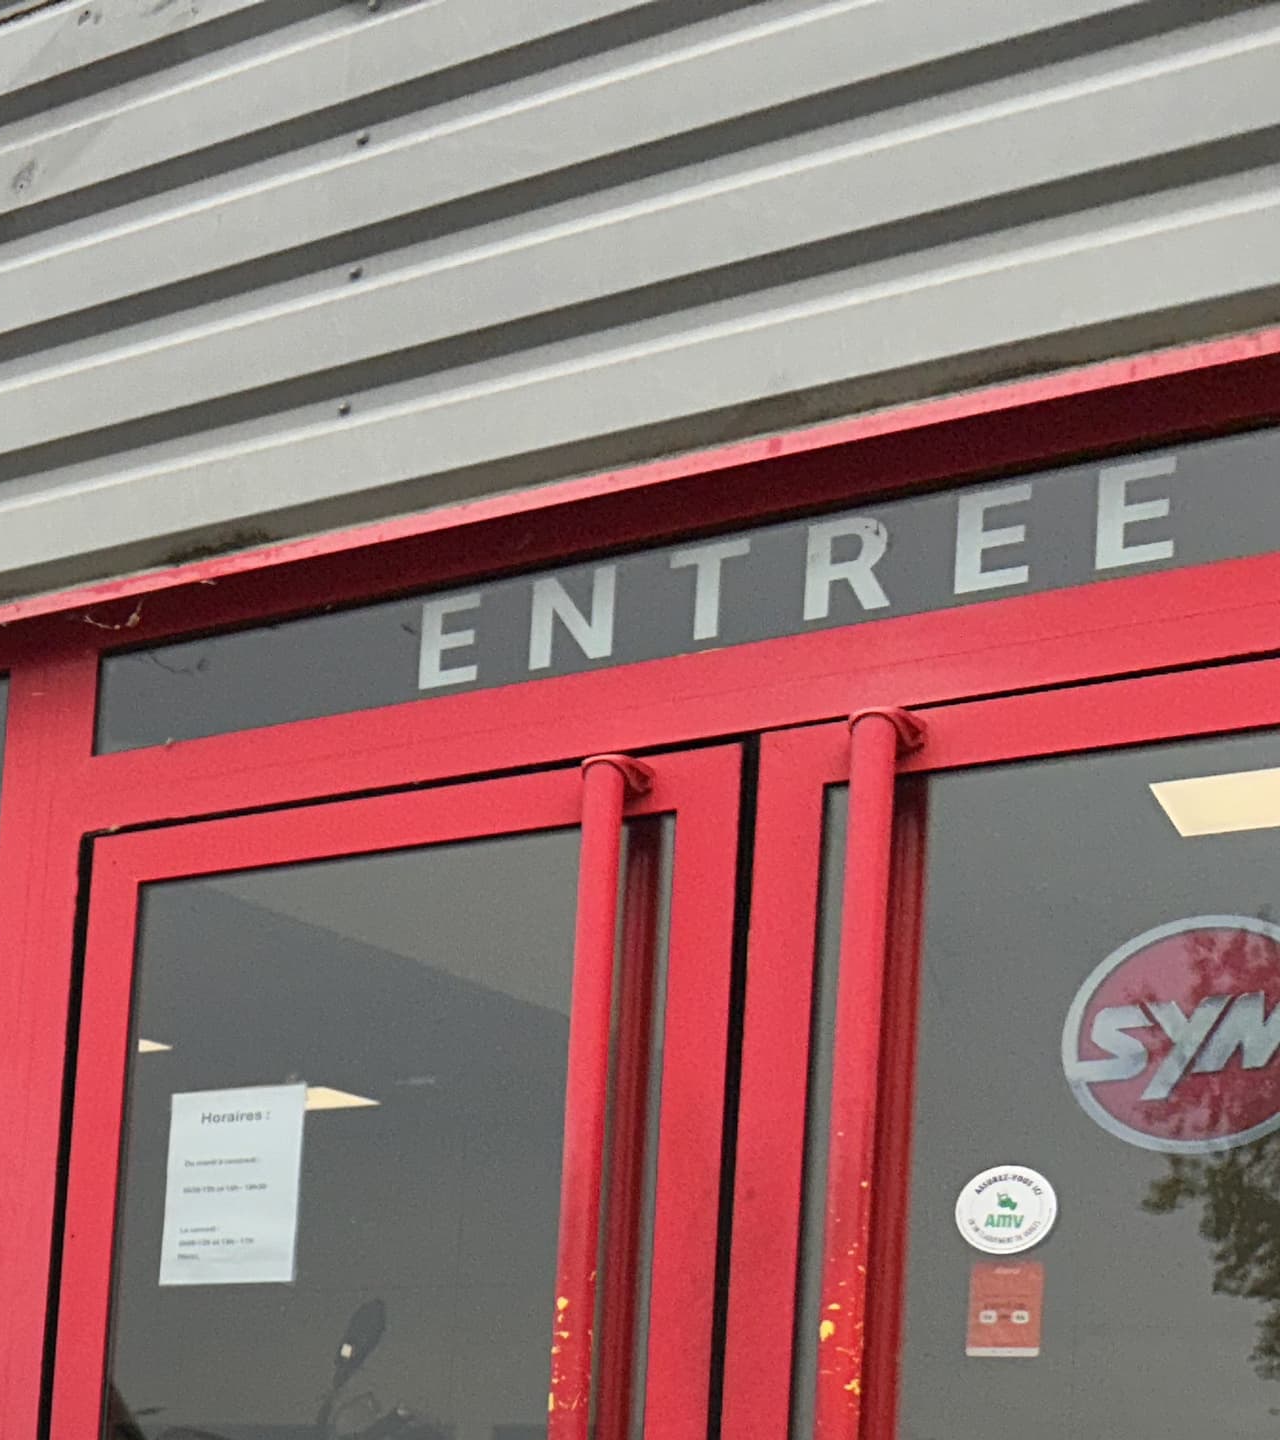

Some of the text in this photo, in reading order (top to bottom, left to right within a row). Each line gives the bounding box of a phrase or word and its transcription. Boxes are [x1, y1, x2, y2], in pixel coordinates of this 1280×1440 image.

[417, 455, 1178, 691] ENTREE
[1068, 990, 1280, 1100] SYM
[201, 1111, 263, 1125] Horaires
